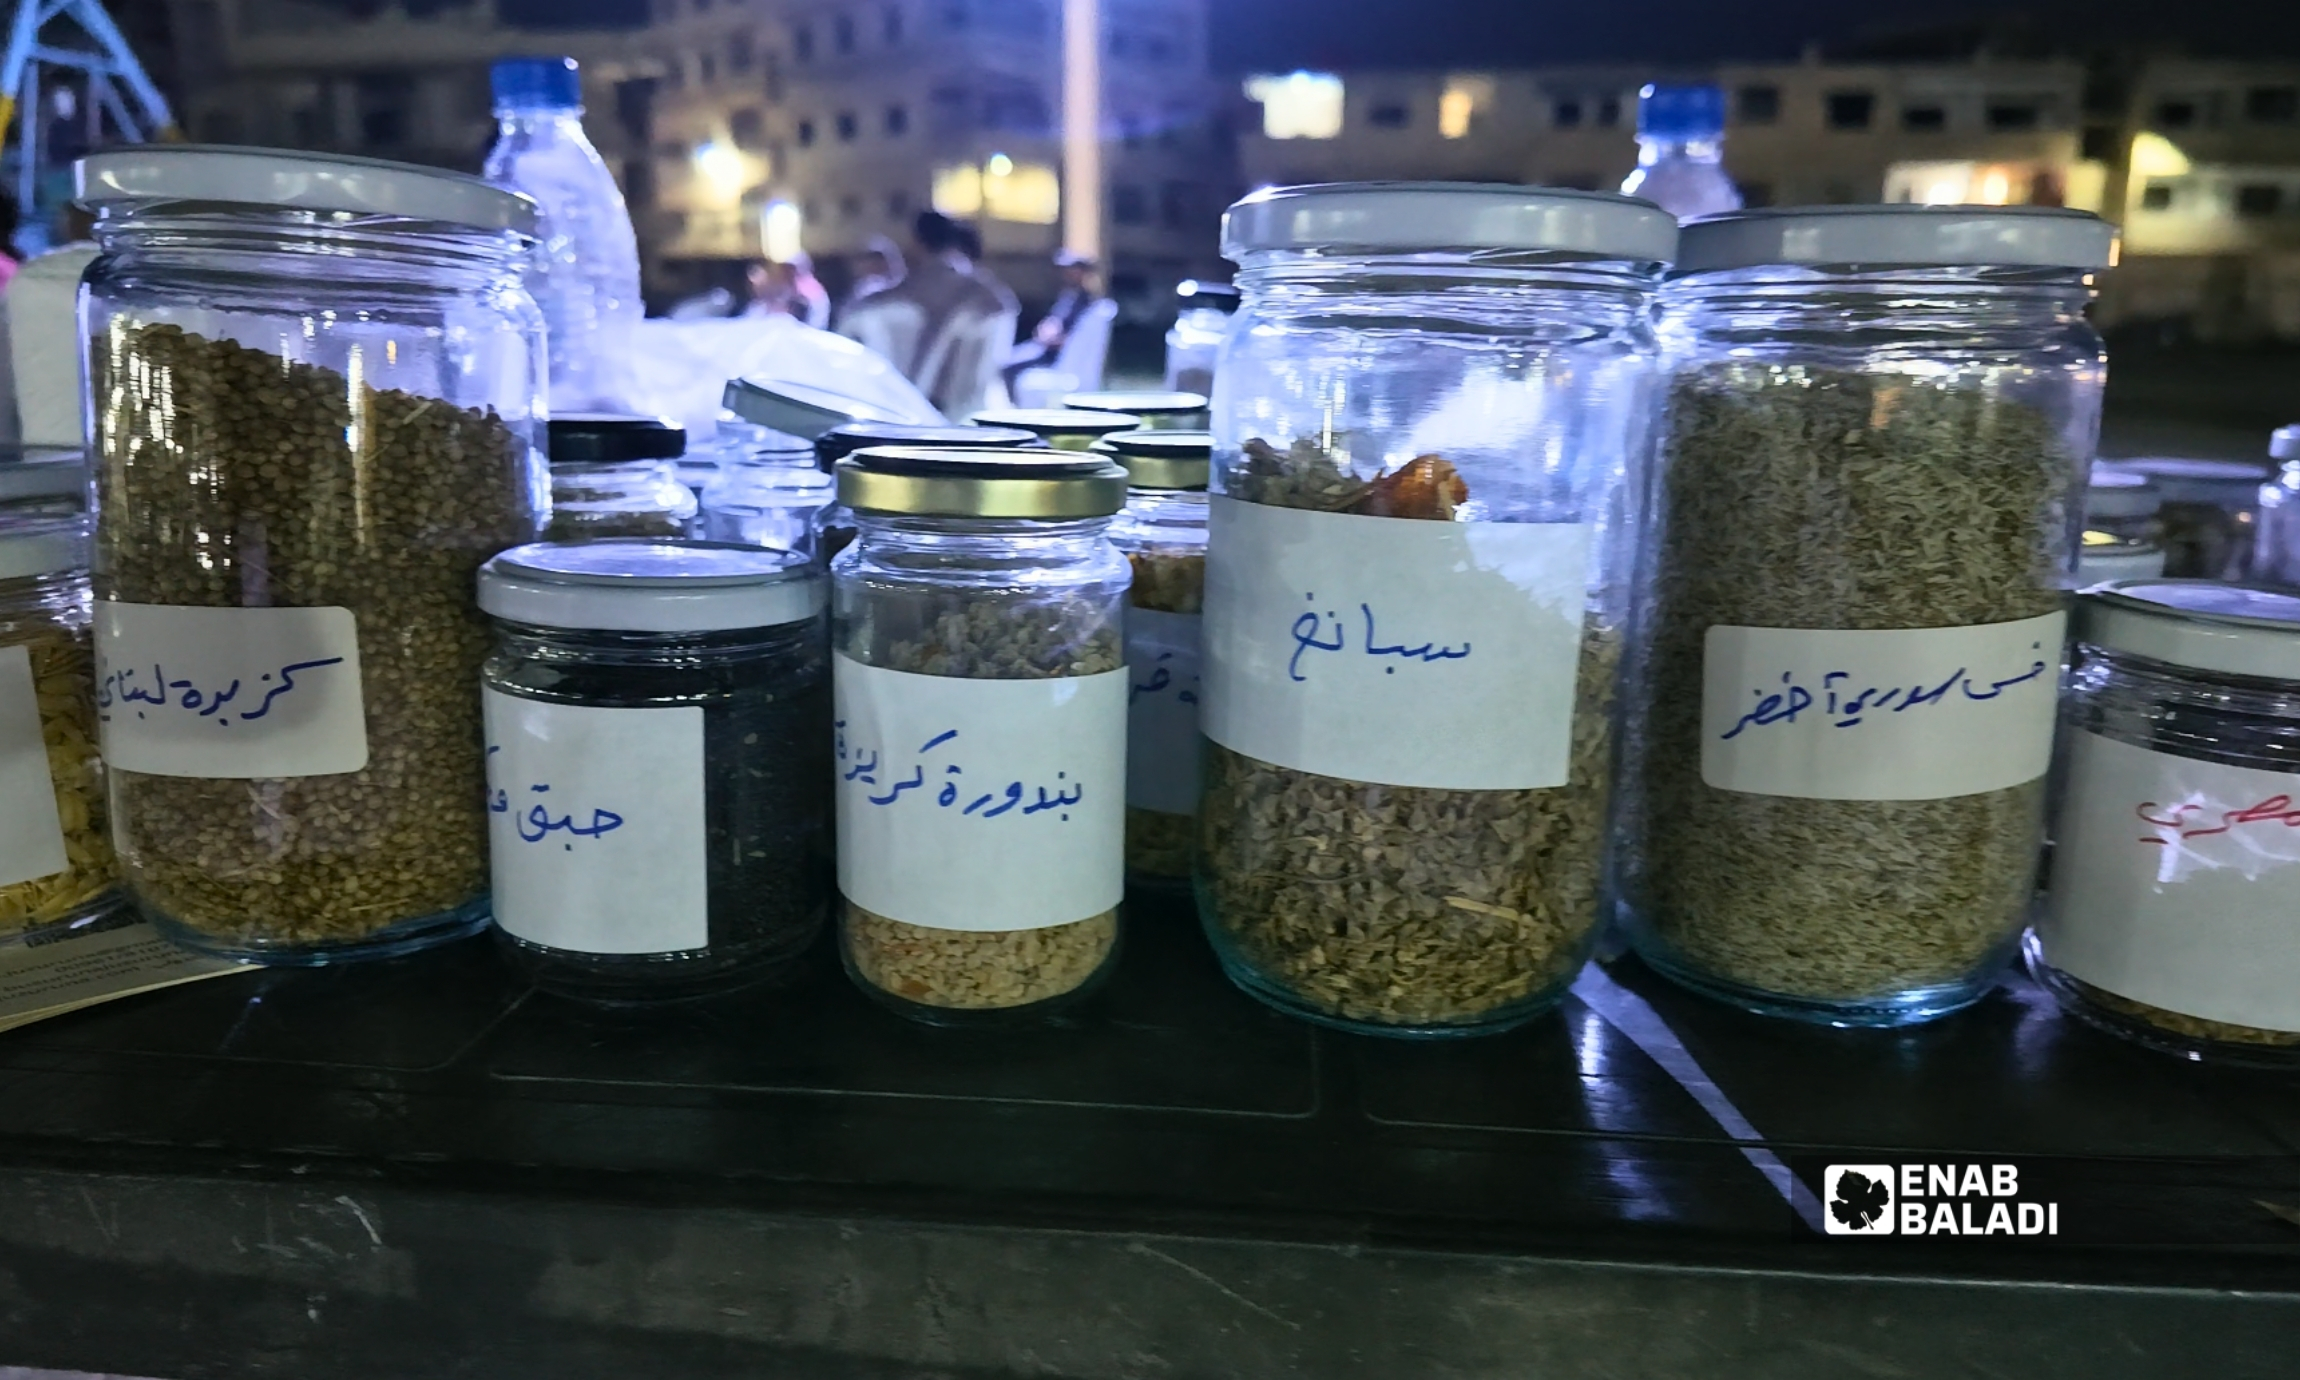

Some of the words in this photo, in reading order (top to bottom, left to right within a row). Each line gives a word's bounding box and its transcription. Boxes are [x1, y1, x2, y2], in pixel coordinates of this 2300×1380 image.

[1289, 592, 1471, 681] سبانخ
[168, 656, 344, 727] كزبرة
[516, 783, 624, 851] حبق
[937, 764, 1083, 822] بندورة
